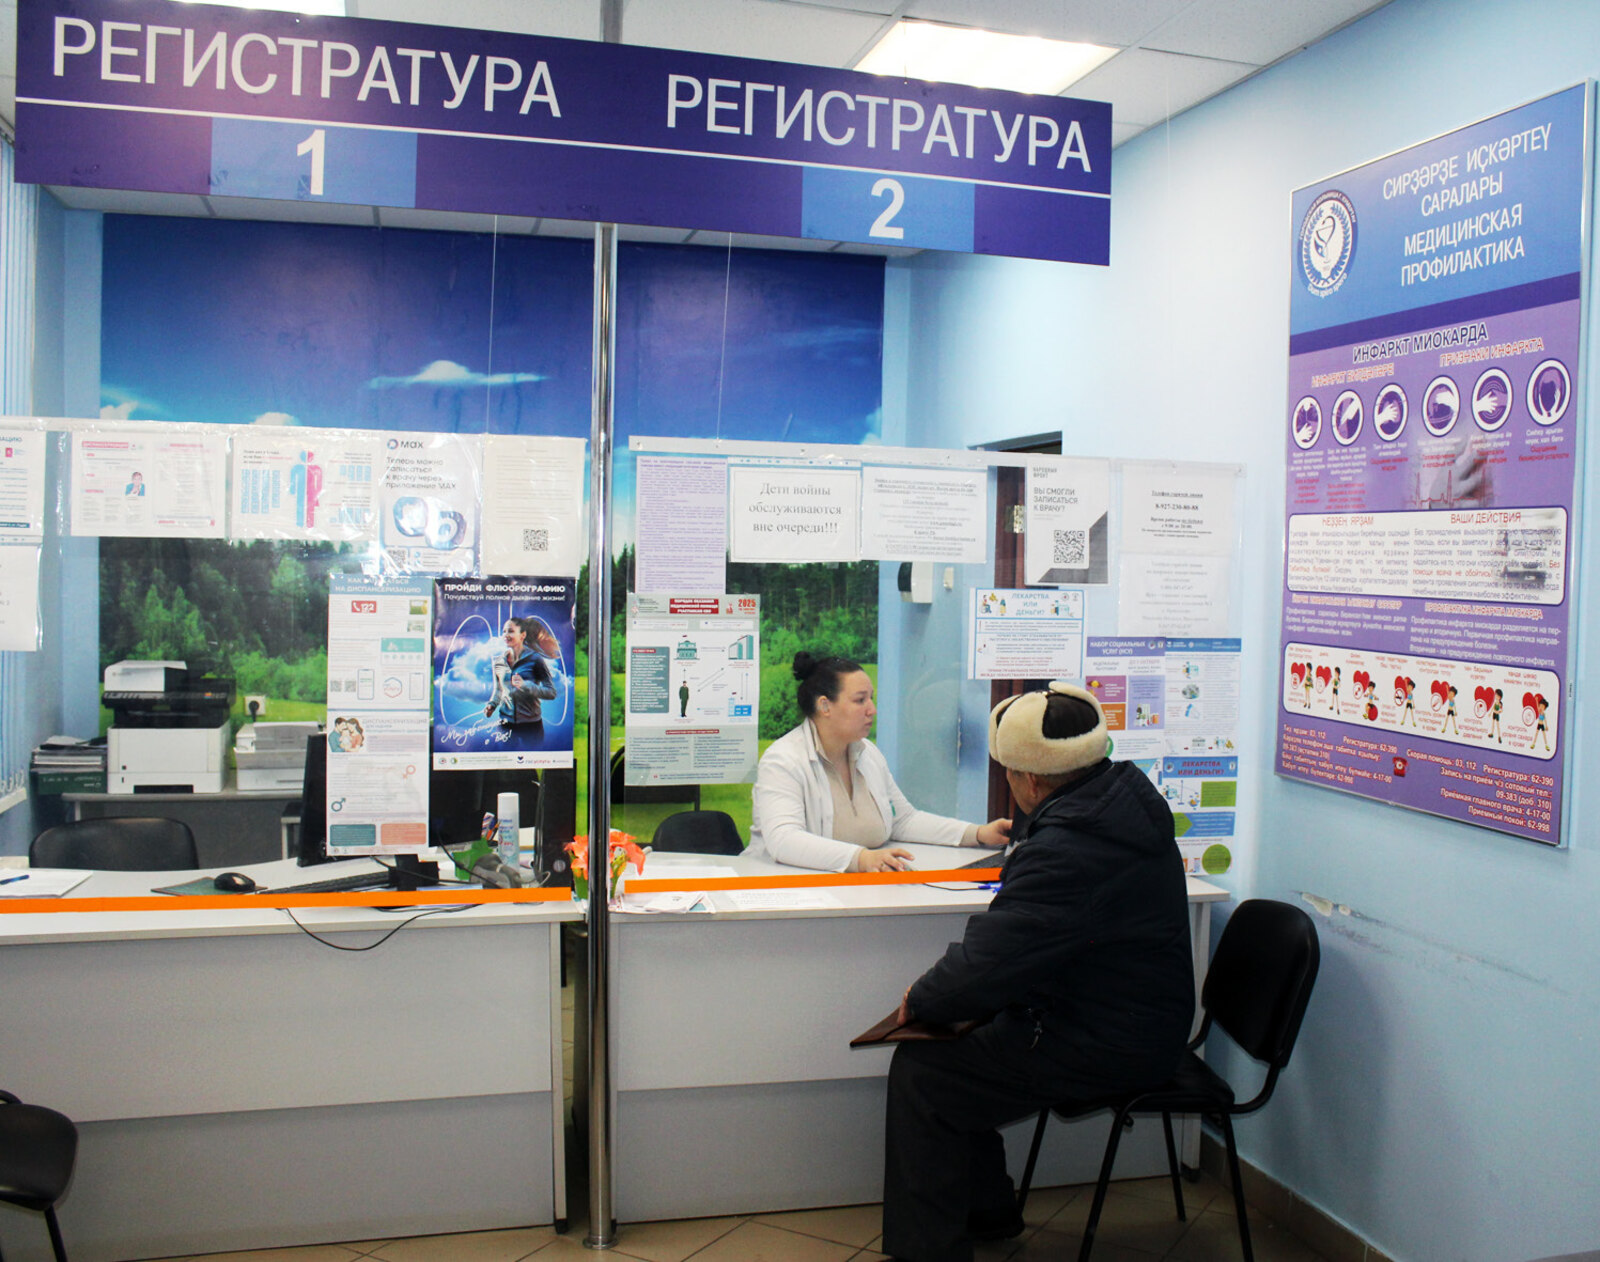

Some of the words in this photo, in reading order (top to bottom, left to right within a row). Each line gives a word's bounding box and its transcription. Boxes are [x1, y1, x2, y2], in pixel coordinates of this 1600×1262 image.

[53, 16, 562, 118] РЕГИСТРАТУРА
[667, 74, 1092, 173] РЕГИСТРАТУРА
[296, 129, 325, 196] 1
[1422, 172, 1503, 216] САРАЛАРЫ
[868, 178, 905, 240] 2
[1405, 203, 1522, 257] МЕДИЦИНСКАЯ
[1401, 236, 1524, 286] ПРОФИЛАКТИКА
[1353, 338, 1410, 363] ИНФАРКТ
[1413, 322, 1487, 354] МИОКАРДА
[1440, 348, 1489, 367] ПРИЗНАКИ
[1491, 337, 1544, 359] ИНФАРКТА
[759, 483, 789, 497] Дети
[793, 484, 830, 496] войны
[749, 503, 842, 517] обслуживаются
[1450, 514, 1474, 524] ВАШИ
[1476, 512, 1521, 523] ДЕЙСТВИЯ
[753, 523, 773, 532] вне
[776, 522, 838, 536] очереди!!!
[444, 593, 484, 601] Почувствуй
[445, 582, 482, 592] ПРОЙДИ
[485, 584, 566, 593] ФЛЮОРОГРАФИЮ
[1406, 749, 1427, 760] Скорая
[1428, 754, 1454, 766] помощь:
[1483, 764, 1529, 782] Регистратура:
[1531, 774, 1554, 786] 62-390
[1441, 767, 1462, 779] Запись
[1505, 782, 1535, 794] сотовый
[1472, 796, 1501, 809] главного
[1502, 801, 1524, 815] врача:
[1526, 808, 1550, 821] 4-17-00
[1496, 790, 1518, 802] 09-383
[1518, 794, 1536, 806] (доб.
[1537, 798, 1552, 810] 310)
[1504, 813, 1526, 827] покой:
[1527, 820, 1550, 833] 62-998
